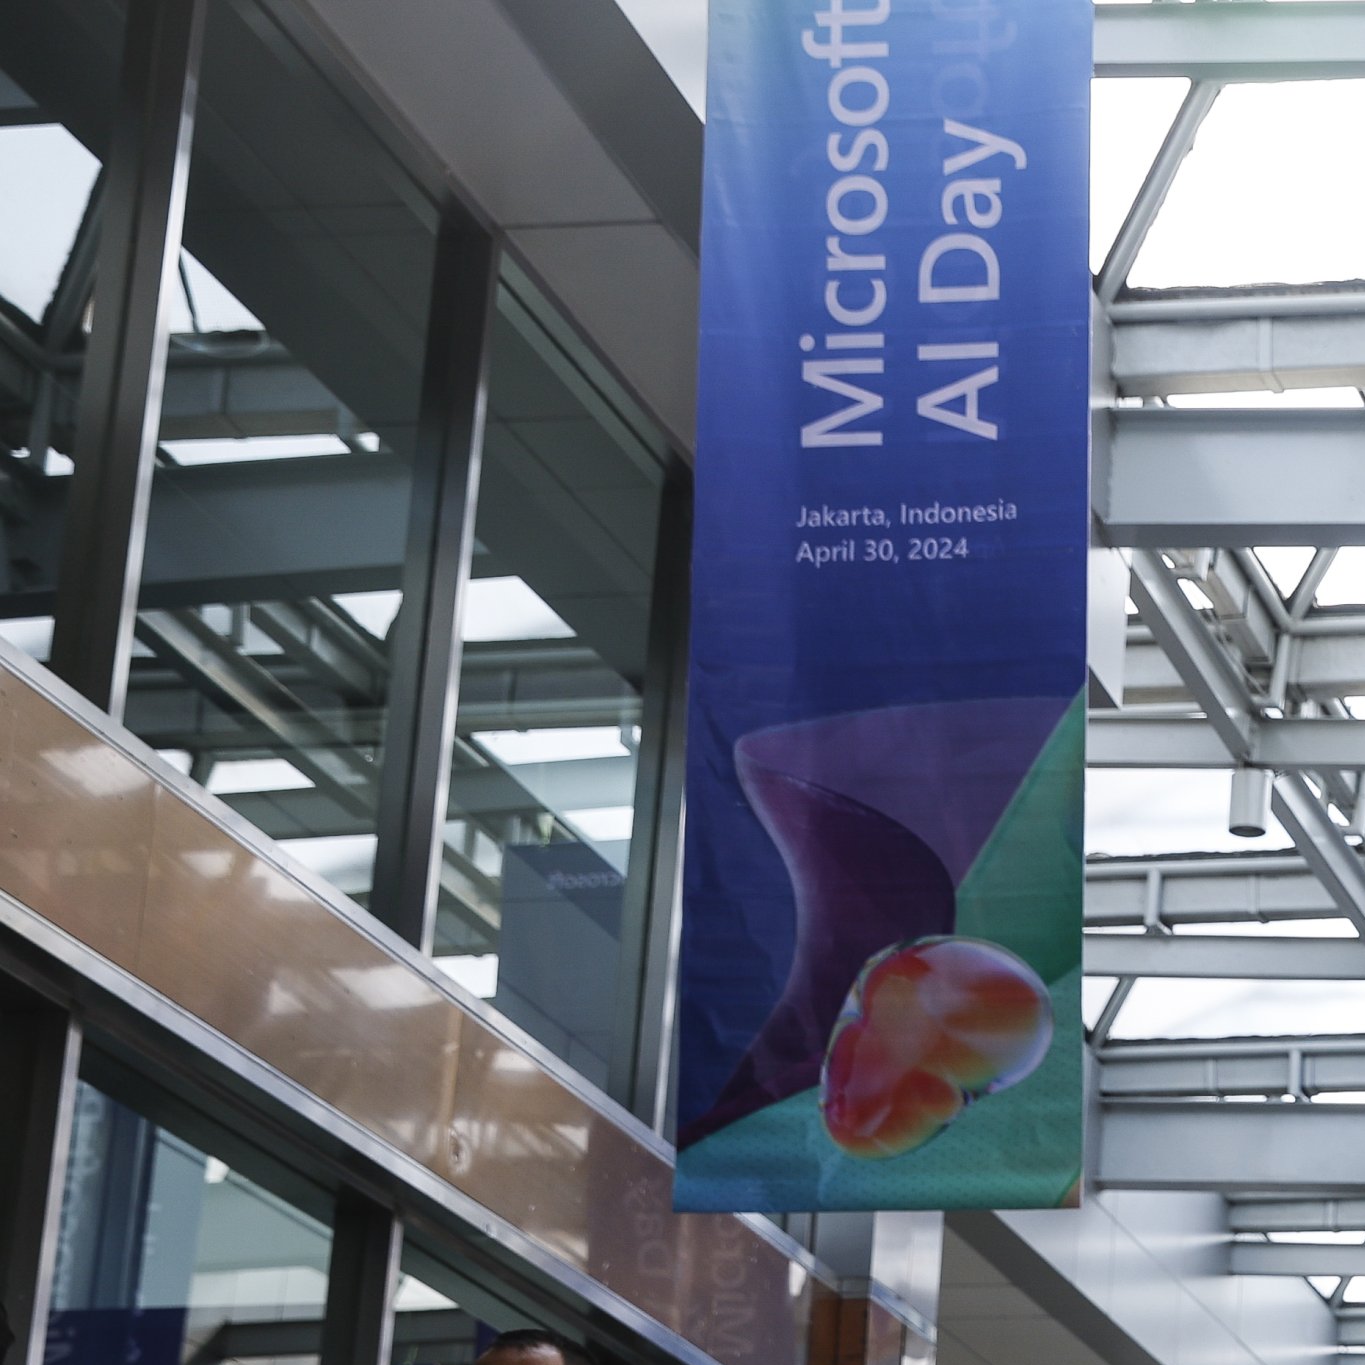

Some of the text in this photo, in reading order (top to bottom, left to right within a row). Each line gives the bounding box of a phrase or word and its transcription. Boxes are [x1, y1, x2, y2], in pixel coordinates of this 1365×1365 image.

[801, 0, 894, 447] Microsoft
[919, 117, 1027, 302] Day
[917, 342, 998, 440] AI
[796, 498, 1017, 528] Jakarta, Indonesia
[796, 537, 969, 569] April 30, 2024
